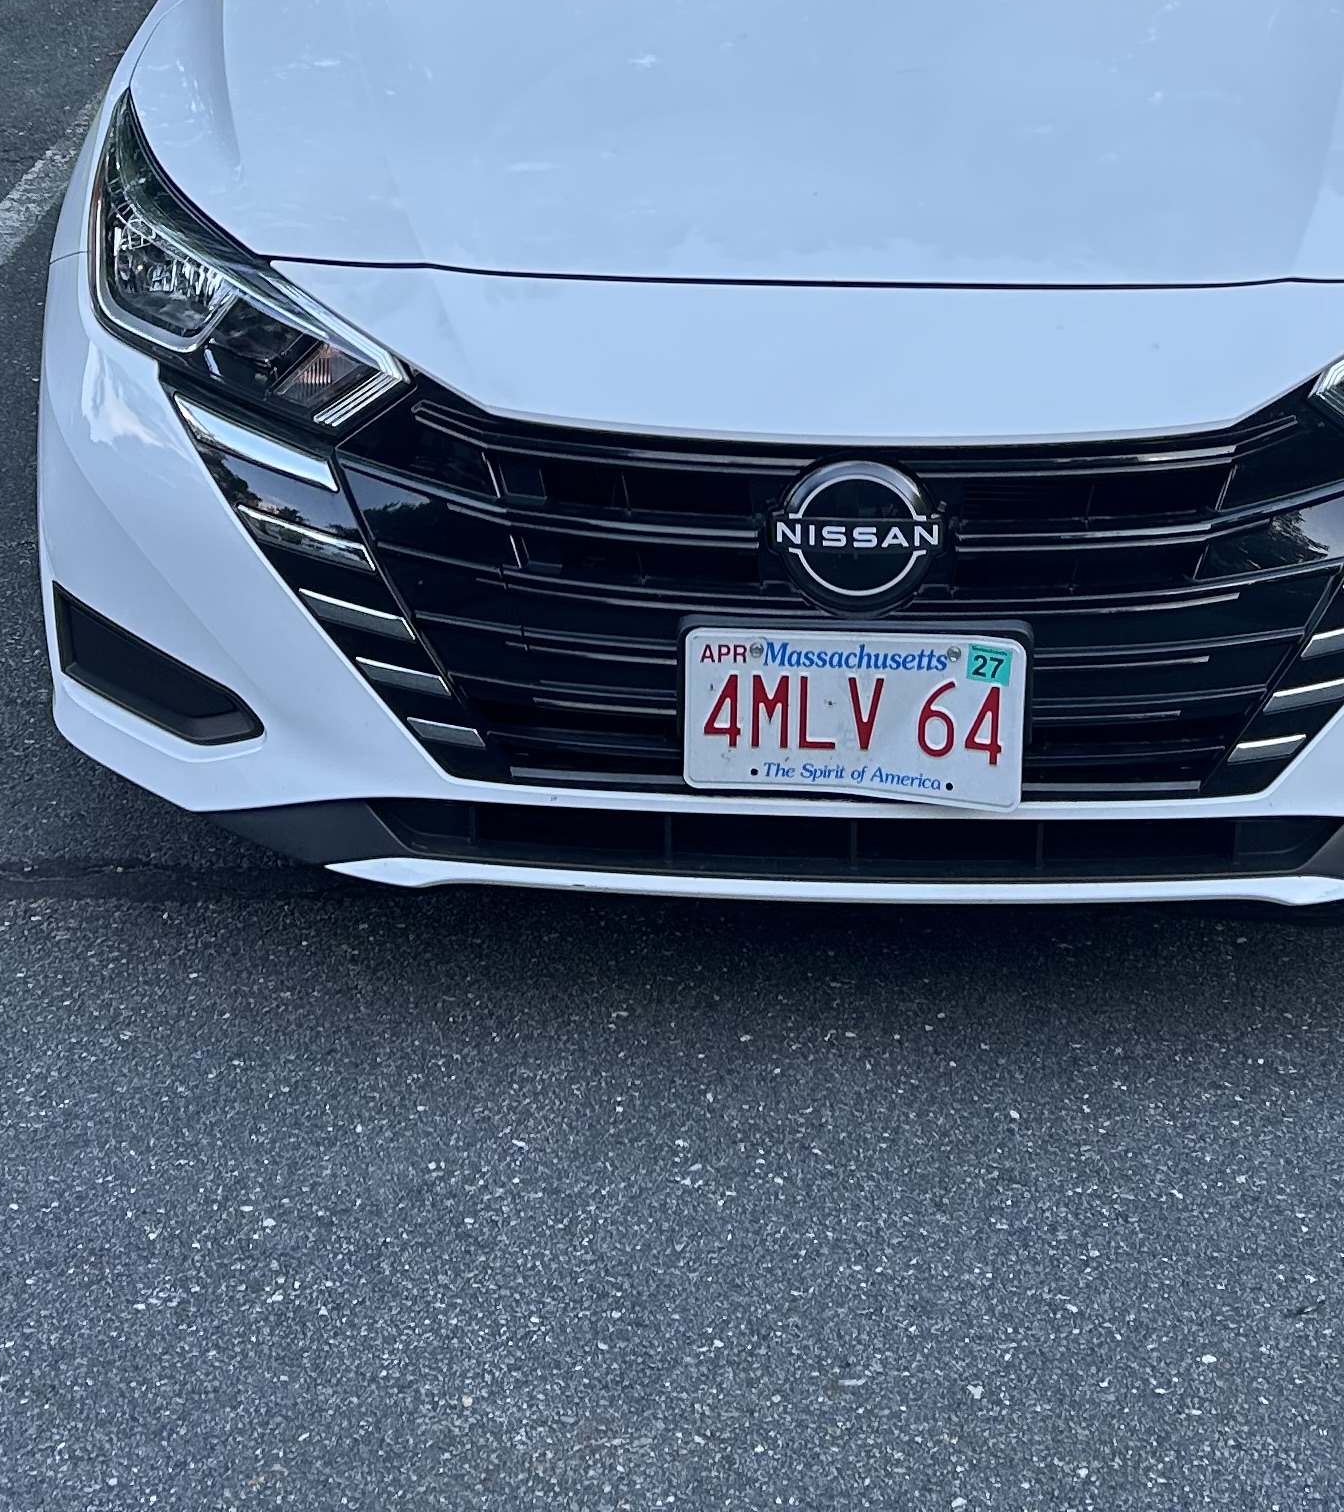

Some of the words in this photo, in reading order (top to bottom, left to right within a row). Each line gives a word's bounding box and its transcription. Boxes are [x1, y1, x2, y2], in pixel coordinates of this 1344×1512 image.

[776, 521, 939, 548] NISSAN
[700, 644, 748, 664] APR
[762, 641, 948, 672] Massachusetts
[972, 654, 1005, 678] 27
[703, 673, 885, 750] 4MLV
[917, 680, 1002, 766] 64
[763, 762, 796, 779] The
[799, 762, 846, 783] Spirit
[850, 765, 869, 784] of
[871, 768, 942, 791] America
